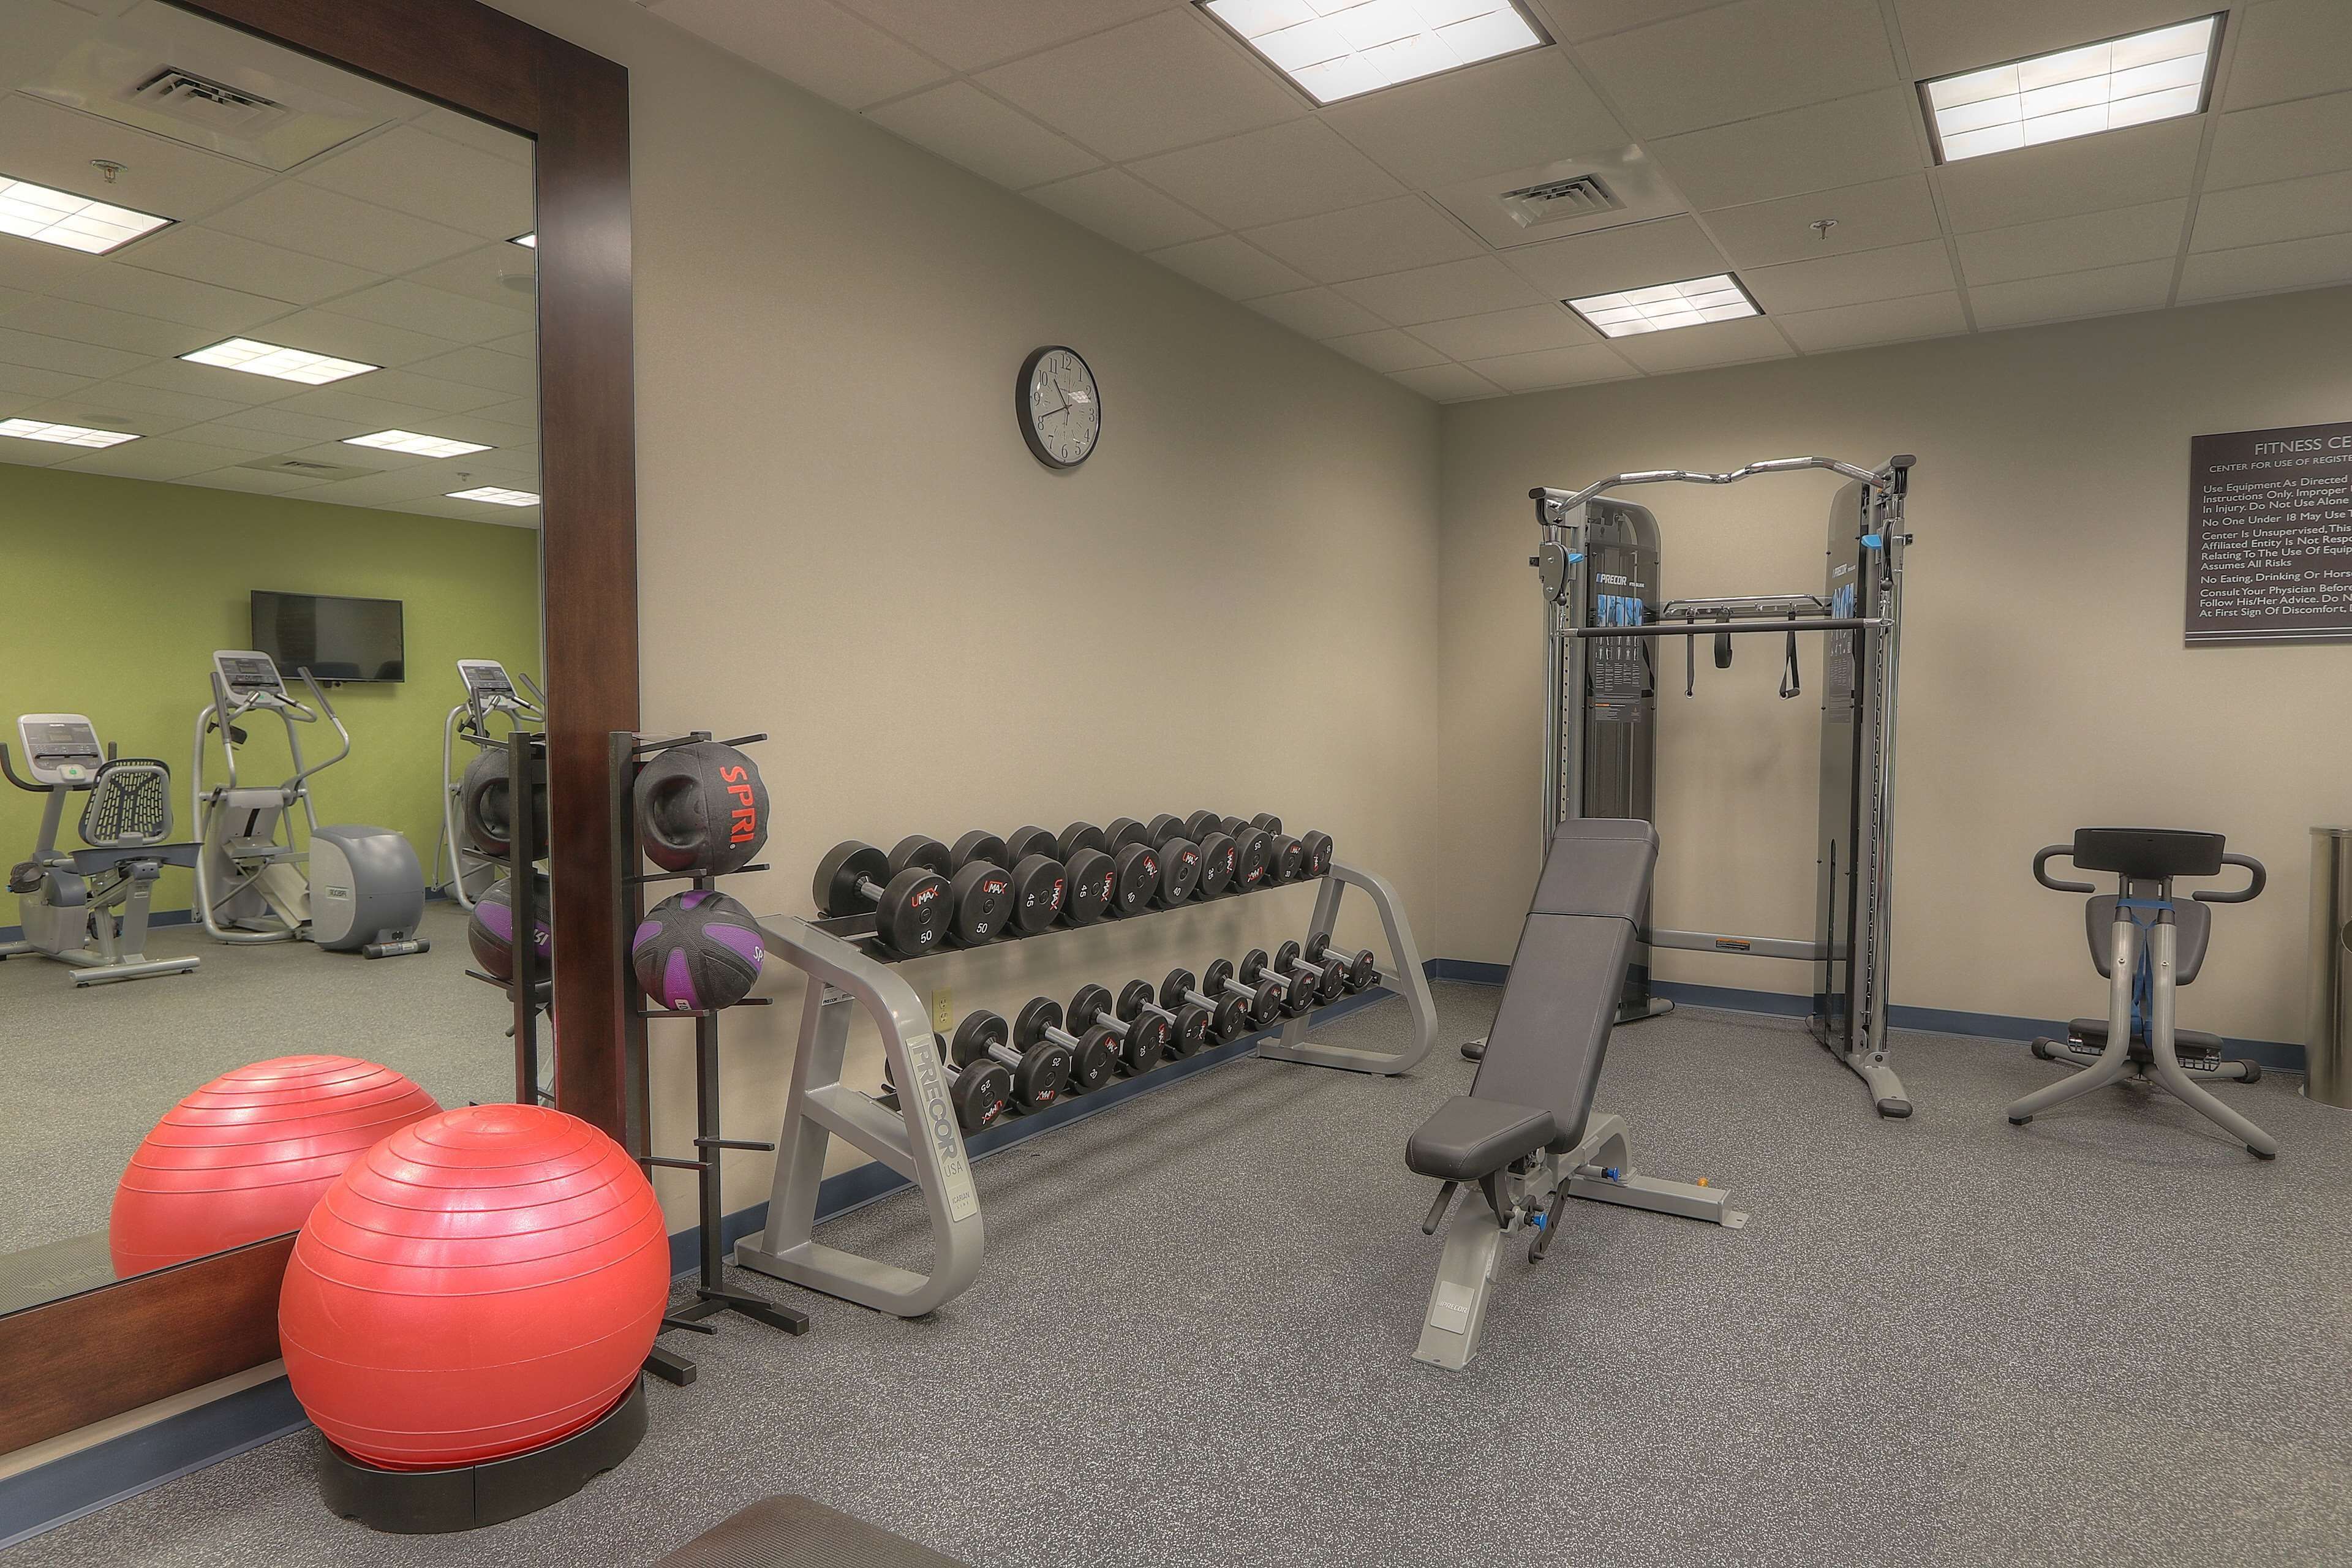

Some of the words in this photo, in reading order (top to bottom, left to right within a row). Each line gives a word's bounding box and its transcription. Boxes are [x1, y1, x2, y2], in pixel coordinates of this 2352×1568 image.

[1049, 357, 1058, 375] 11
[1061, 353, 1072, 371] 12
[1039, 369, 1048, 386] 10
[1079, 368, 1083, 382] 1
[1033, 392, 1040, 406] 9
[1085, 385, 1091, 401] 2
[1089, 408, 1095, 422] 3
[1038, 416, 1044, 430] 8
[1048, 435, 1054, 449] 7
[1084, 428, 1090, 442] 4
[1061, 444, 1068, 458] 6
[1075, 441, 1081, 455] 5
[2255, 439, 2321, 455] FITNESS
[2209, 463, 2248, 472] CENTER
[2226, 481, 2282, 492] Equipment
[2301, 474, 2348, 486] Directed
[2203, 493, 2263, 503] Instructions
[2267, 490, 2293, 500] Only.
[2296, 488, 2347, 498] Improper
[2215, 505, 2247, 514] Injury.
[2294, 499, 2315, 507] Use
[2316, 497, 2349, 506] Alone
[2248, 515, 2282, 524] Under
[2300, 512, 2321, 522] May
[2253, 525, 2328, 538] Unsupervised,
[2201, 540, 2247, 550] Affiliated
[2252, 539, 2282, 548] Entity
[2201, 552, 2242, 560] Relating
[2282, 548, 2302, 556] Use
[2305, 546, 2321, 554] Of
[2247, 560, 2261, 568] All
[2265, 559, 2292, 567] Risks
[1600, 574, 1627, 586] PRECOR
[2256, 573, 2301, 582] Drinking
[2304, 570, 2320, 579] Or
[2324, 570, 2352, 578] Hors
[2200, 588, 2240, 597] Consult
[2269, 585, 2315, 596] Physician
[2237, 597, 2278, 606] His/Her
[2215, 608, 2238, 617] First
[2241, 608, 2261, 618] Sign
[2265, 606, 2280, 615] Of
[720, 765, 757, 843] SPRI
[1254, 840, 1262, 851] 35
[1182, 851, 1199, 867] UMAX
[1143, 856, 1158, 879] UMAX
[1208, 867, 1214, 880] 35
[984, 881, 1008, 894] UMAX
[1079, 884, 1088, 898] 45
[1101, 872, 1114, 902] UMAX
[1173, 886, 1182, 896] 40
[911, 885, 938, 907] UMAX
[1026, 893, 1035, 907] 45
[1049, 879, 1063, 911] UMAX
[1127, 892, 1136, 903] 40
[976, 923, 988, 933] 50
[921, 930, 932, 944] 50
[1227, 1025, 1232, 1033] 15
[1140, 1046, 1146, 1057] 20
[1052, 1057, 1061, 1067] 25
[1090, 1068, 1098, 1079] 20
[981, 1079, 991, 1093] 25
[911, 1044, 960, 1164] PRECOR
[981, 1100, 1003, 1125] UMAX
[944, 1161, 963, 1177] USA
[1441, 1301, 1468, 1313] PRECOR
